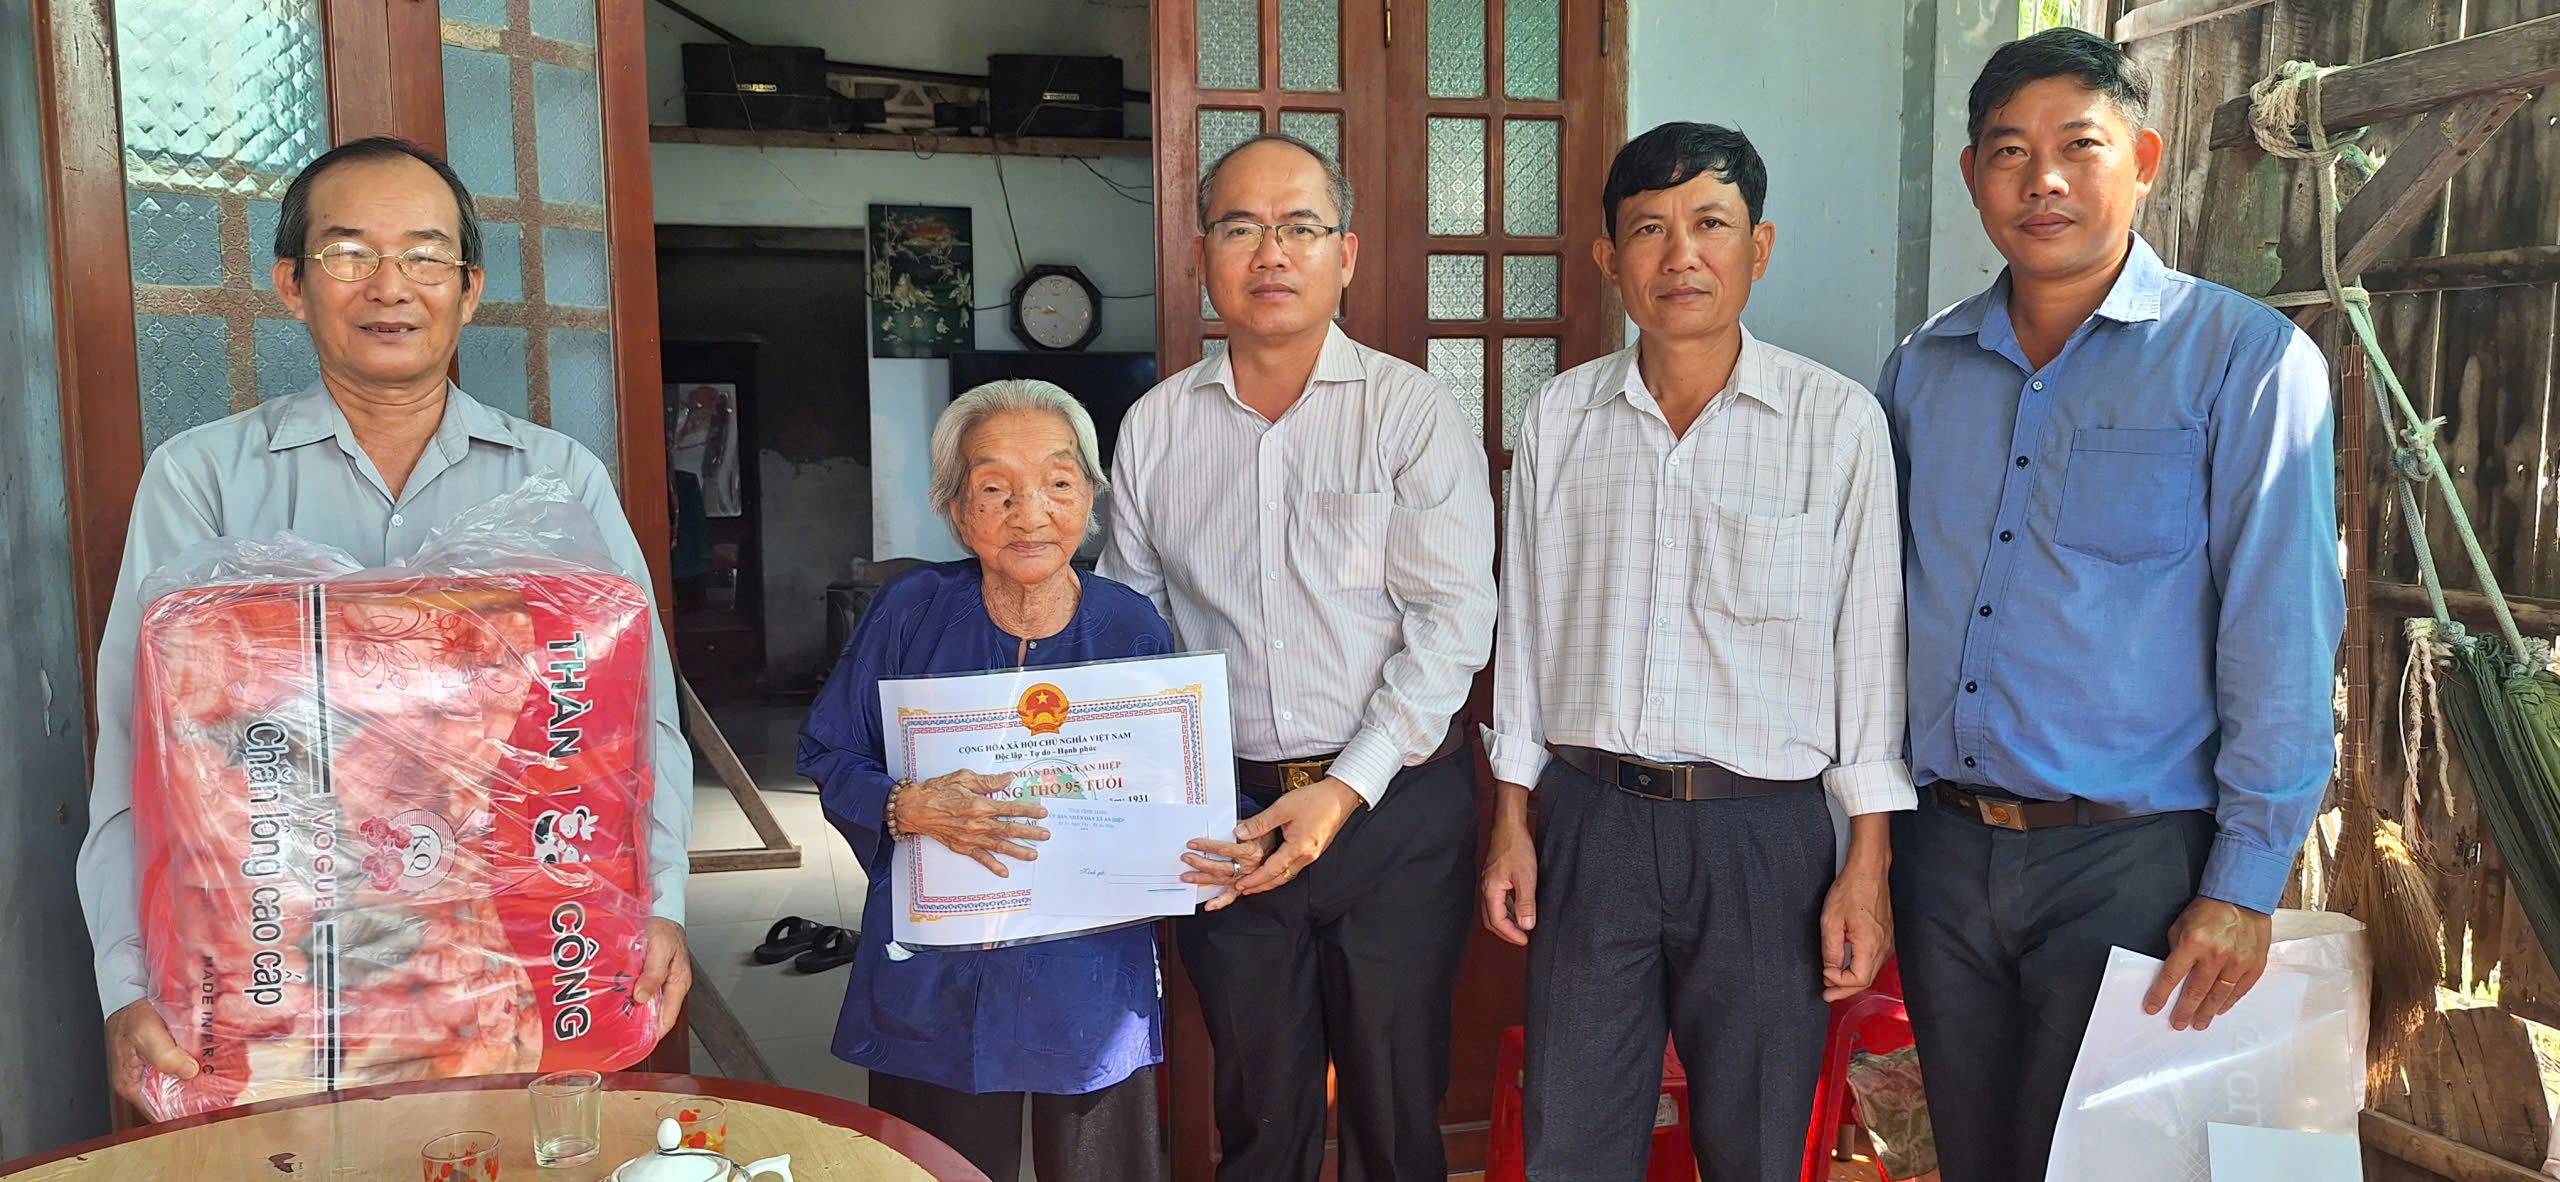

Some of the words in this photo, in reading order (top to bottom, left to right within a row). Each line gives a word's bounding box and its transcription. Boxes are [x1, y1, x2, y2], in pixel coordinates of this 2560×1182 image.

[547, 631, 593, 796] THÀN
[246, 721, 290, 803] Chăn
[958, 745, 984, 755] CỘNG
[1007, 740, 1019, 750] XÃ
[1021, 740, 1038, 749] HỘI
[1060, 735, 1088, 745] NGHĨA
[1089, 733, 1110, 743] VIỆT
[1111, 731, 1132, 741] NAM
[995, 752, 1010, 762] Độc
[1010, 751, 1023, 761] lập
[1029, 750, 1040, 759] Tự
[1041, 749, 1051, 757] do
[1057, 746, 1078, 757] Hạnh
[1079, 744, 1097, 754] phúc
[1083, 763, 1096, 771] AN
[1098, 760, 1121, 771] HIỆP
[1027, 783, 1062, 797] THỌ
[1065, 780, 1081, 793] 95
[1128, 794, 1149, 803] 1931
[242, 812, 290, 876] lông
[313, 811, 335, 909] VOGUE
[409, 833, 431, 870] KQ
[252, 887, 281, 942] cao
[202, 956, 214, 1005] MADE
[244, 951, 302, 1006] cấp
[550, 901, 599, 1041] CÔNG
[201, 1012, 213, 1028] IN
